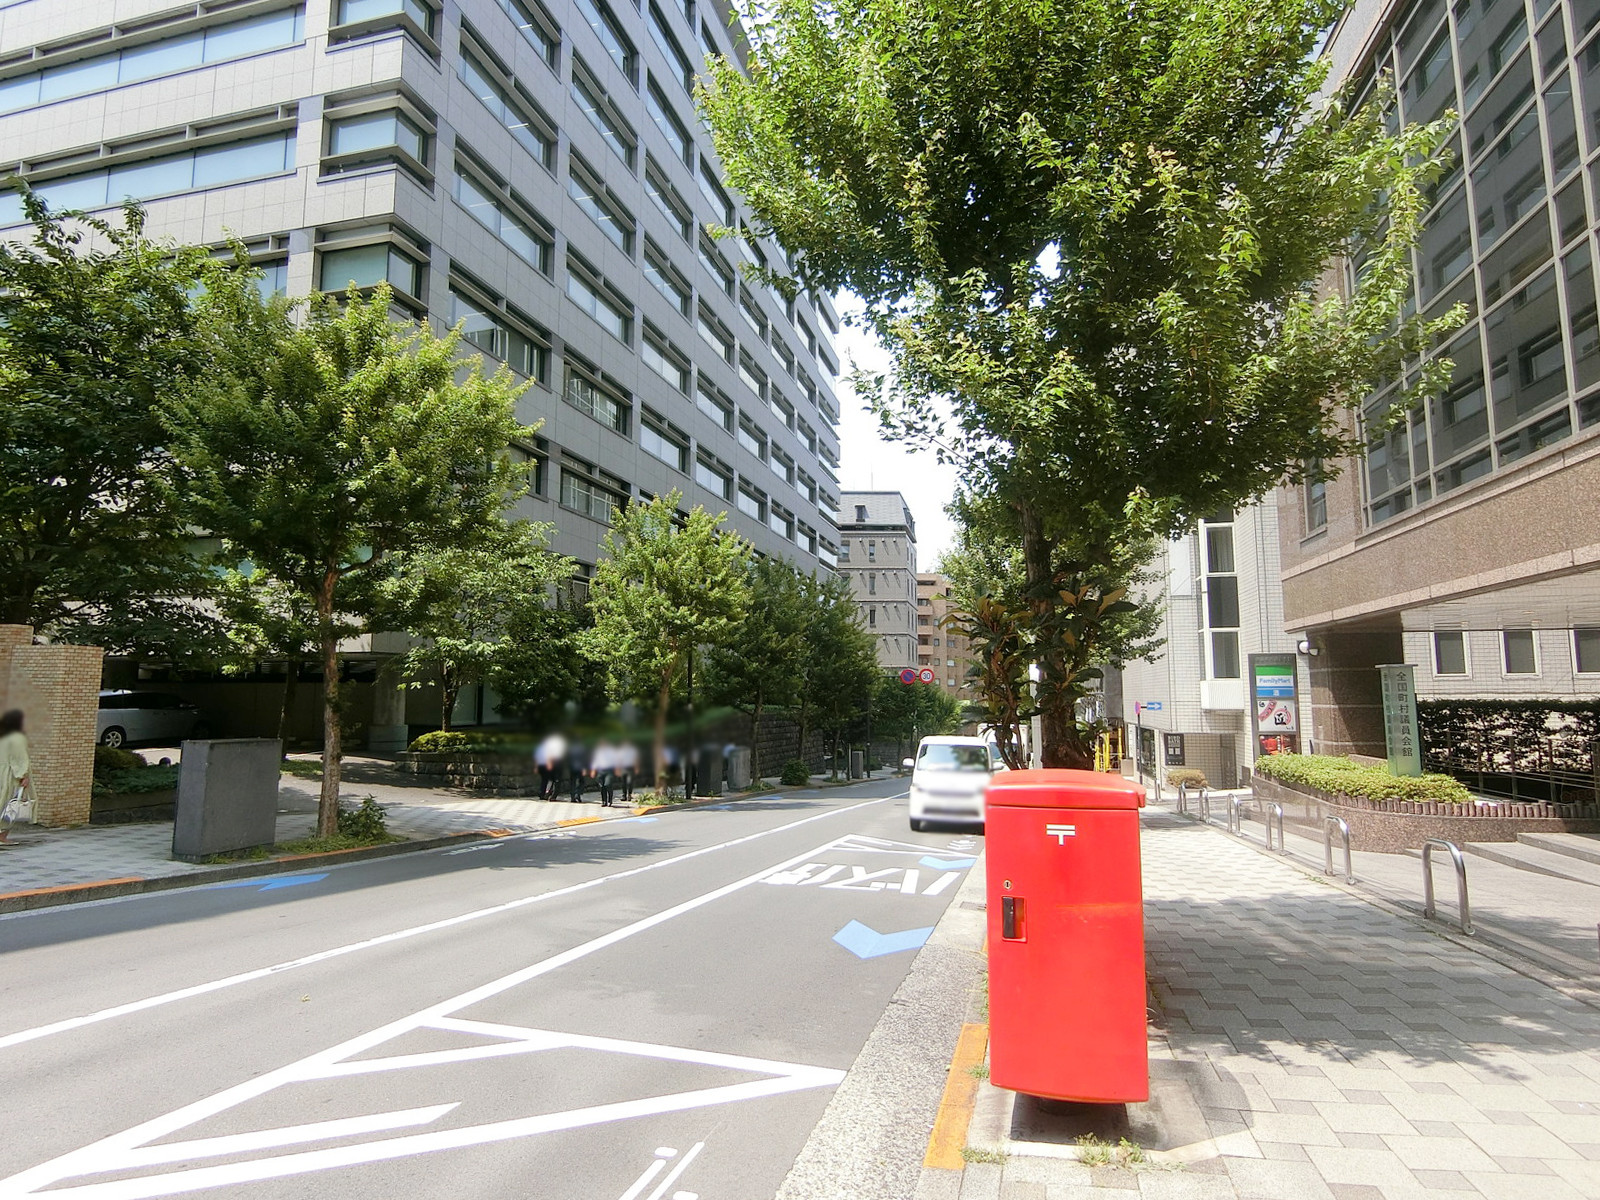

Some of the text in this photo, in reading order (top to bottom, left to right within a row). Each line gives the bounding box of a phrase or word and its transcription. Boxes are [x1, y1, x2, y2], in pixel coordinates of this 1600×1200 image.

[922, 672, 931, 680] 30
[1259, 677, 1292, 685] FamilyMart
[1396, 671, 1413, 757] 全国町村議員会館
